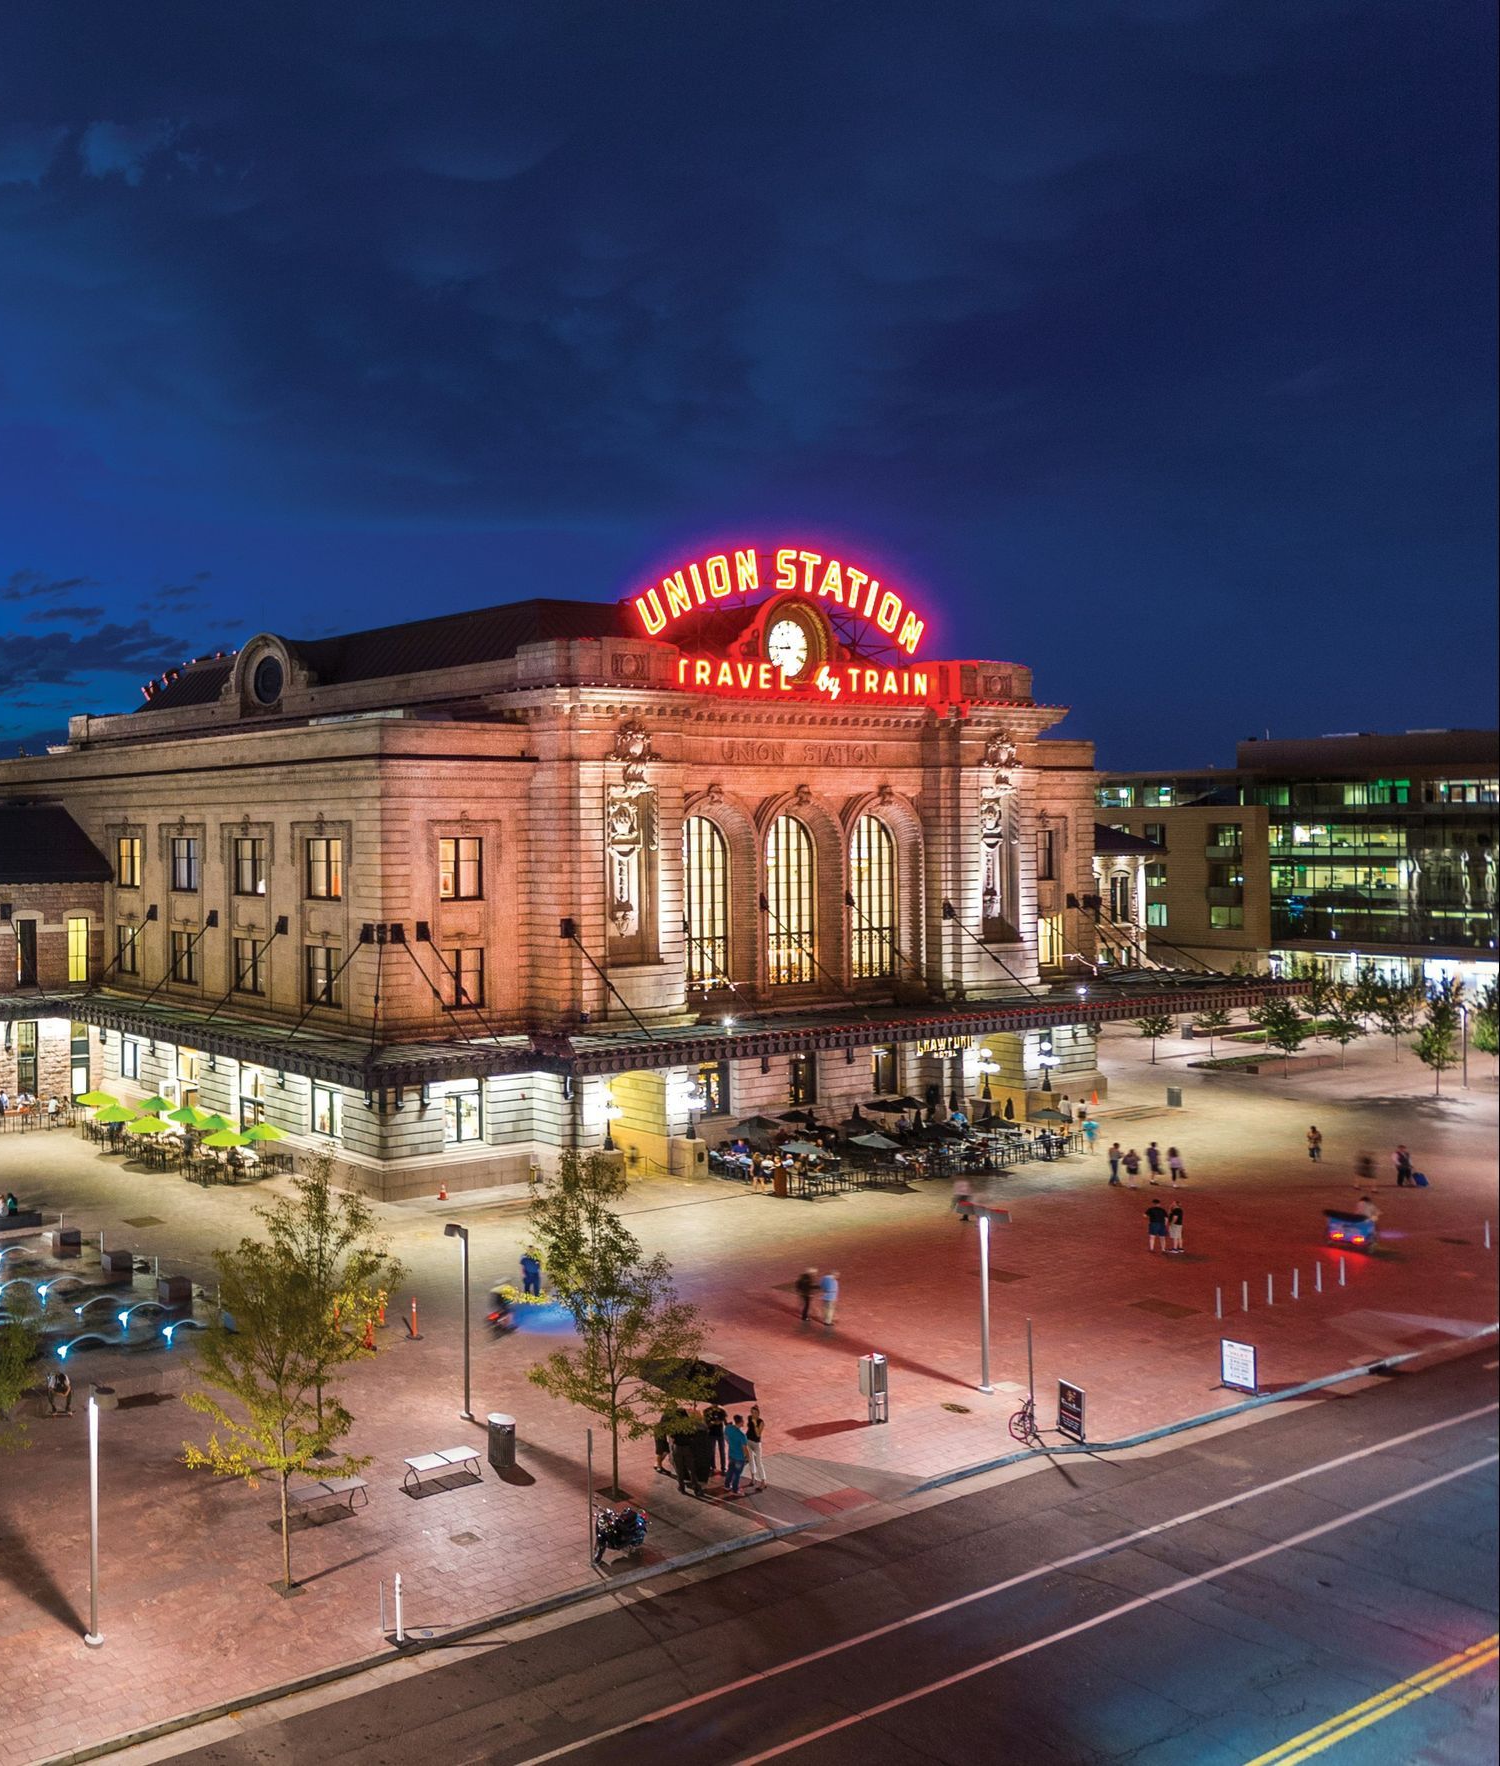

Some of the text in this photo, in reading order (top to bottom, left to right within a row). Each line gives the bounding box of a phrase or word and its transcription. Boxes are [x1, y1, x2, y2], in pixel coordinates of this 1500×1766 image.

[635, 549, 925, 655] UNION STATION
[677, 658, 928, 700] TRAVEL by TRAIN
[721, 741, 878, 764] UNION STATION
[933, 1050, 958, 1059] HOTEL
